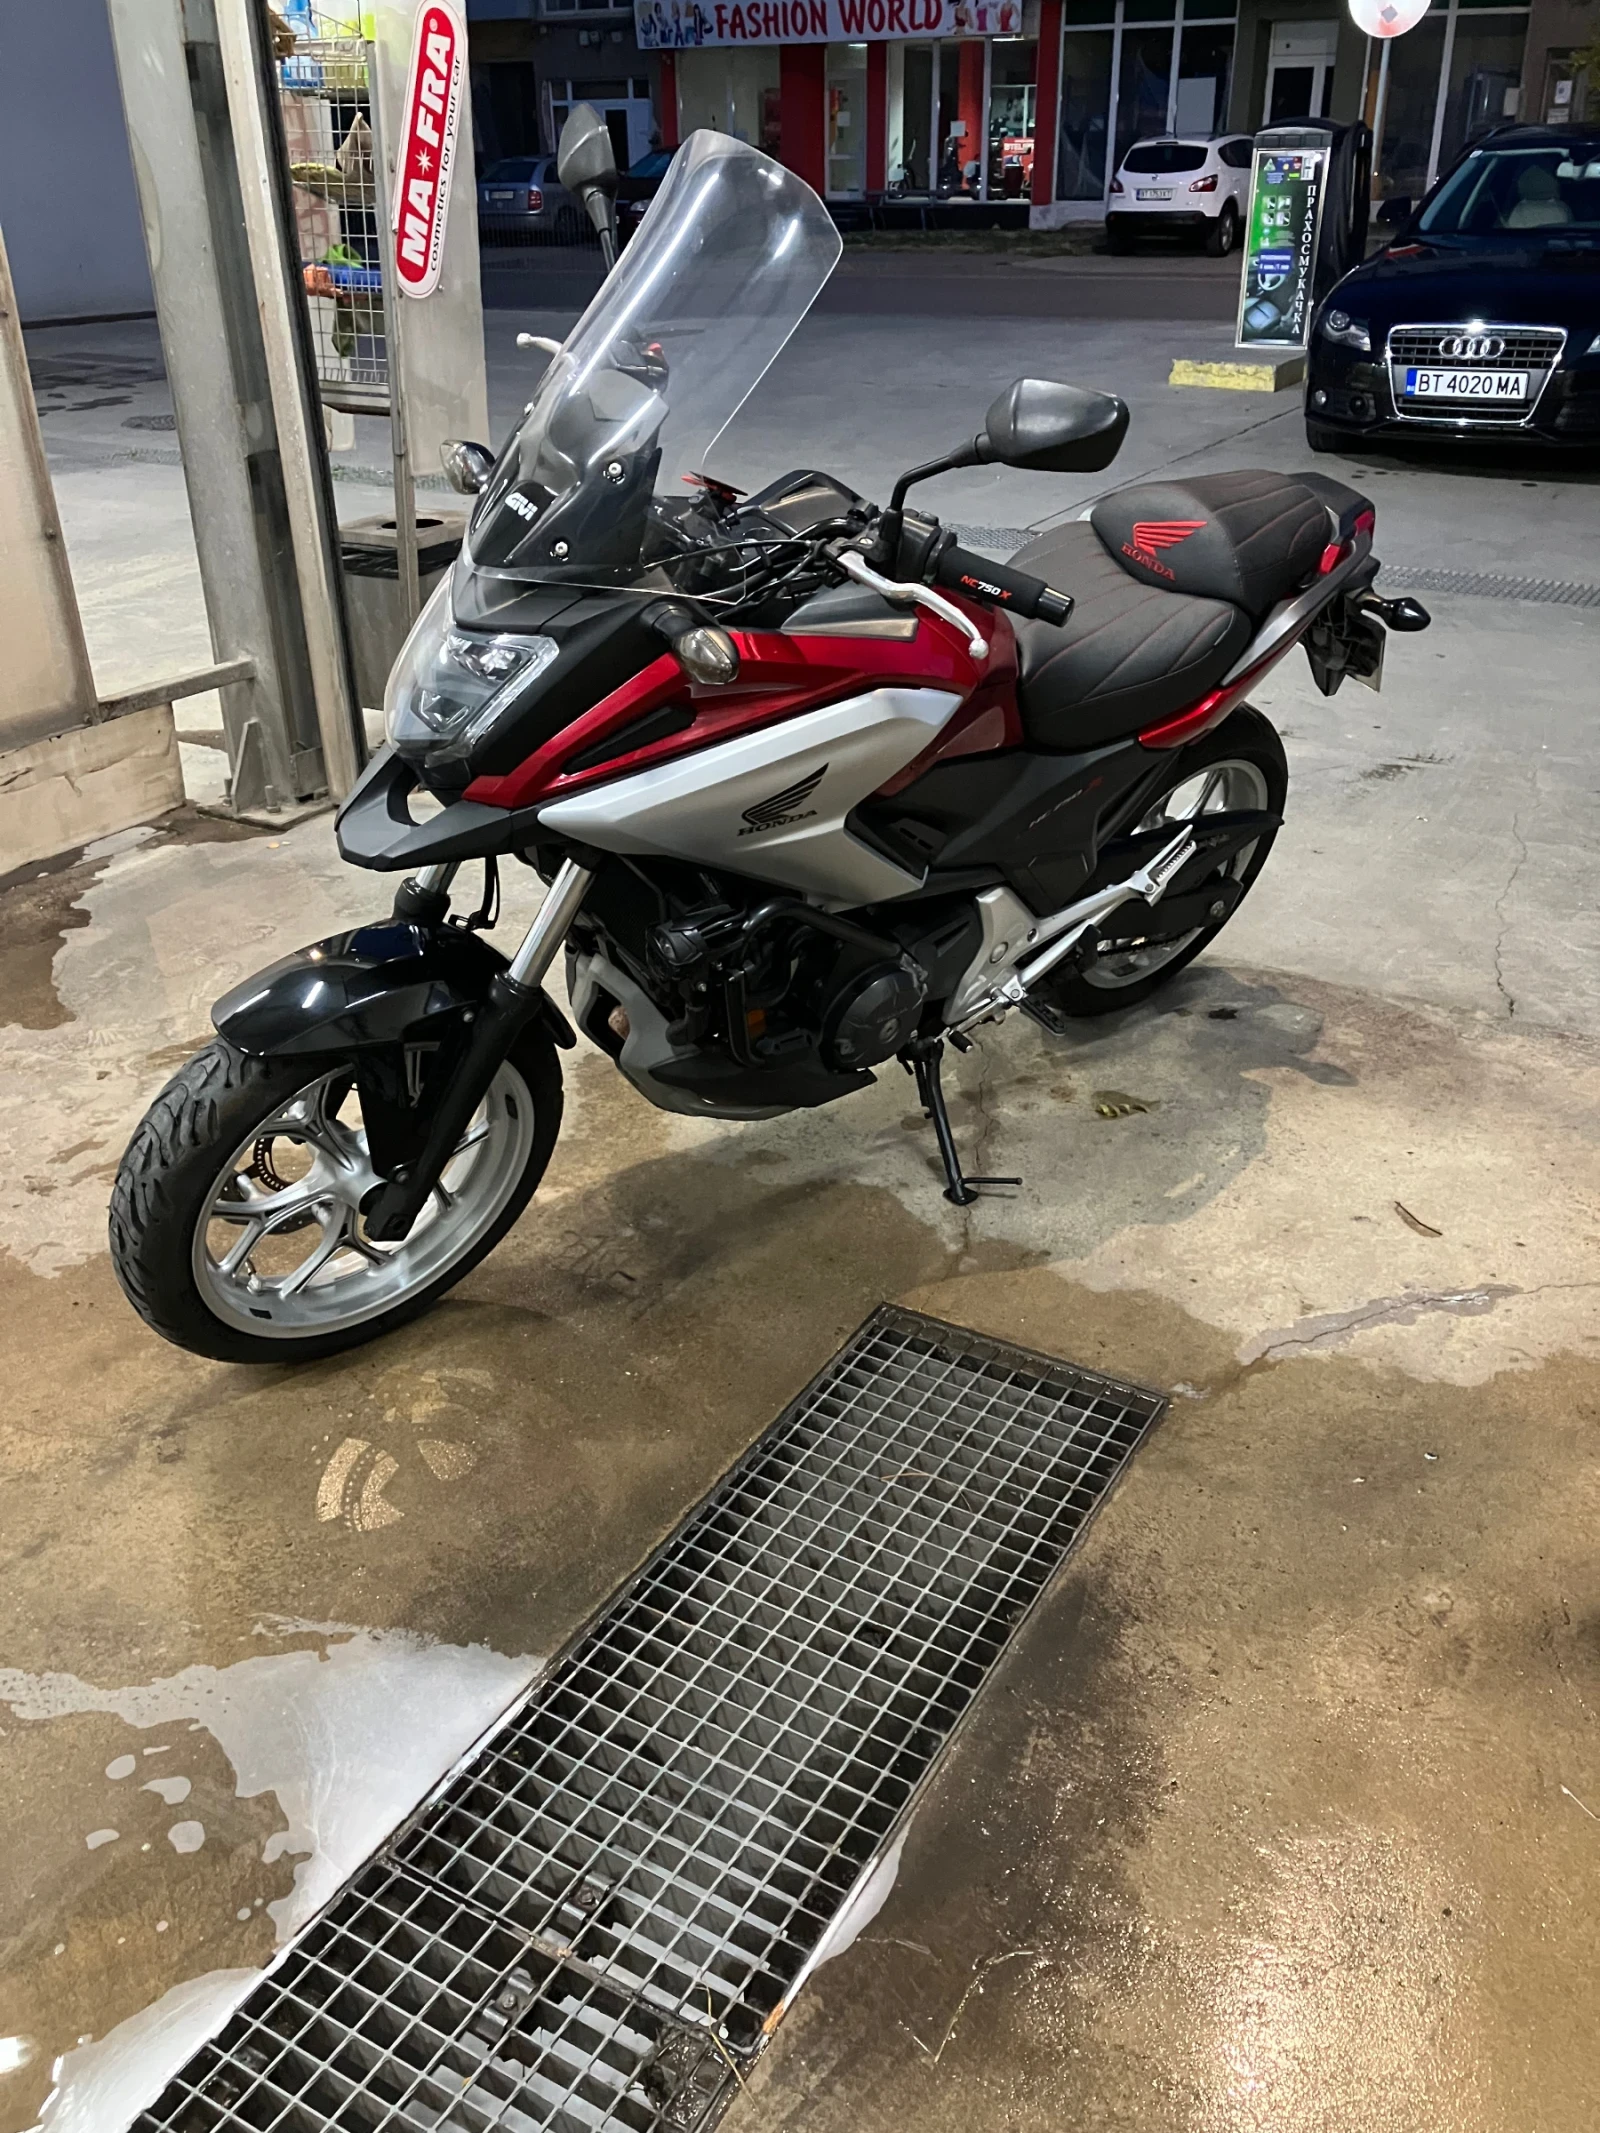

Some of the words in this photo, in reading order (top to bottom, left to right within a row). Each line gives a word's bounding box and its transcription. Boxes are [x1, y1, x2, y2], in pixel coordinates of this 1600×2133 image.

[714, 0, 828, 39] FASHION
[838, 0, 943, 34] WORLD
[431, 179, 447, 271] cosmetics
[441, 147, 451, 171] for
[446, 95, 456, 137] your
[452, 57, 461, 86] car
[1291, 185, 1317, 334] ПРАХОСМУКАЧКА
[1418, 374, 1444, 392] BT
[1446, 375, 1493, 395] 4020
[1496, 376, 1521, 395] MA
[504, 491, 538, 521] GIVI
[1121, 542, 1176, 581] HONDA
[961, 575, 1012, 599] NC750X
[737, 809, 818, 837] HONDA
